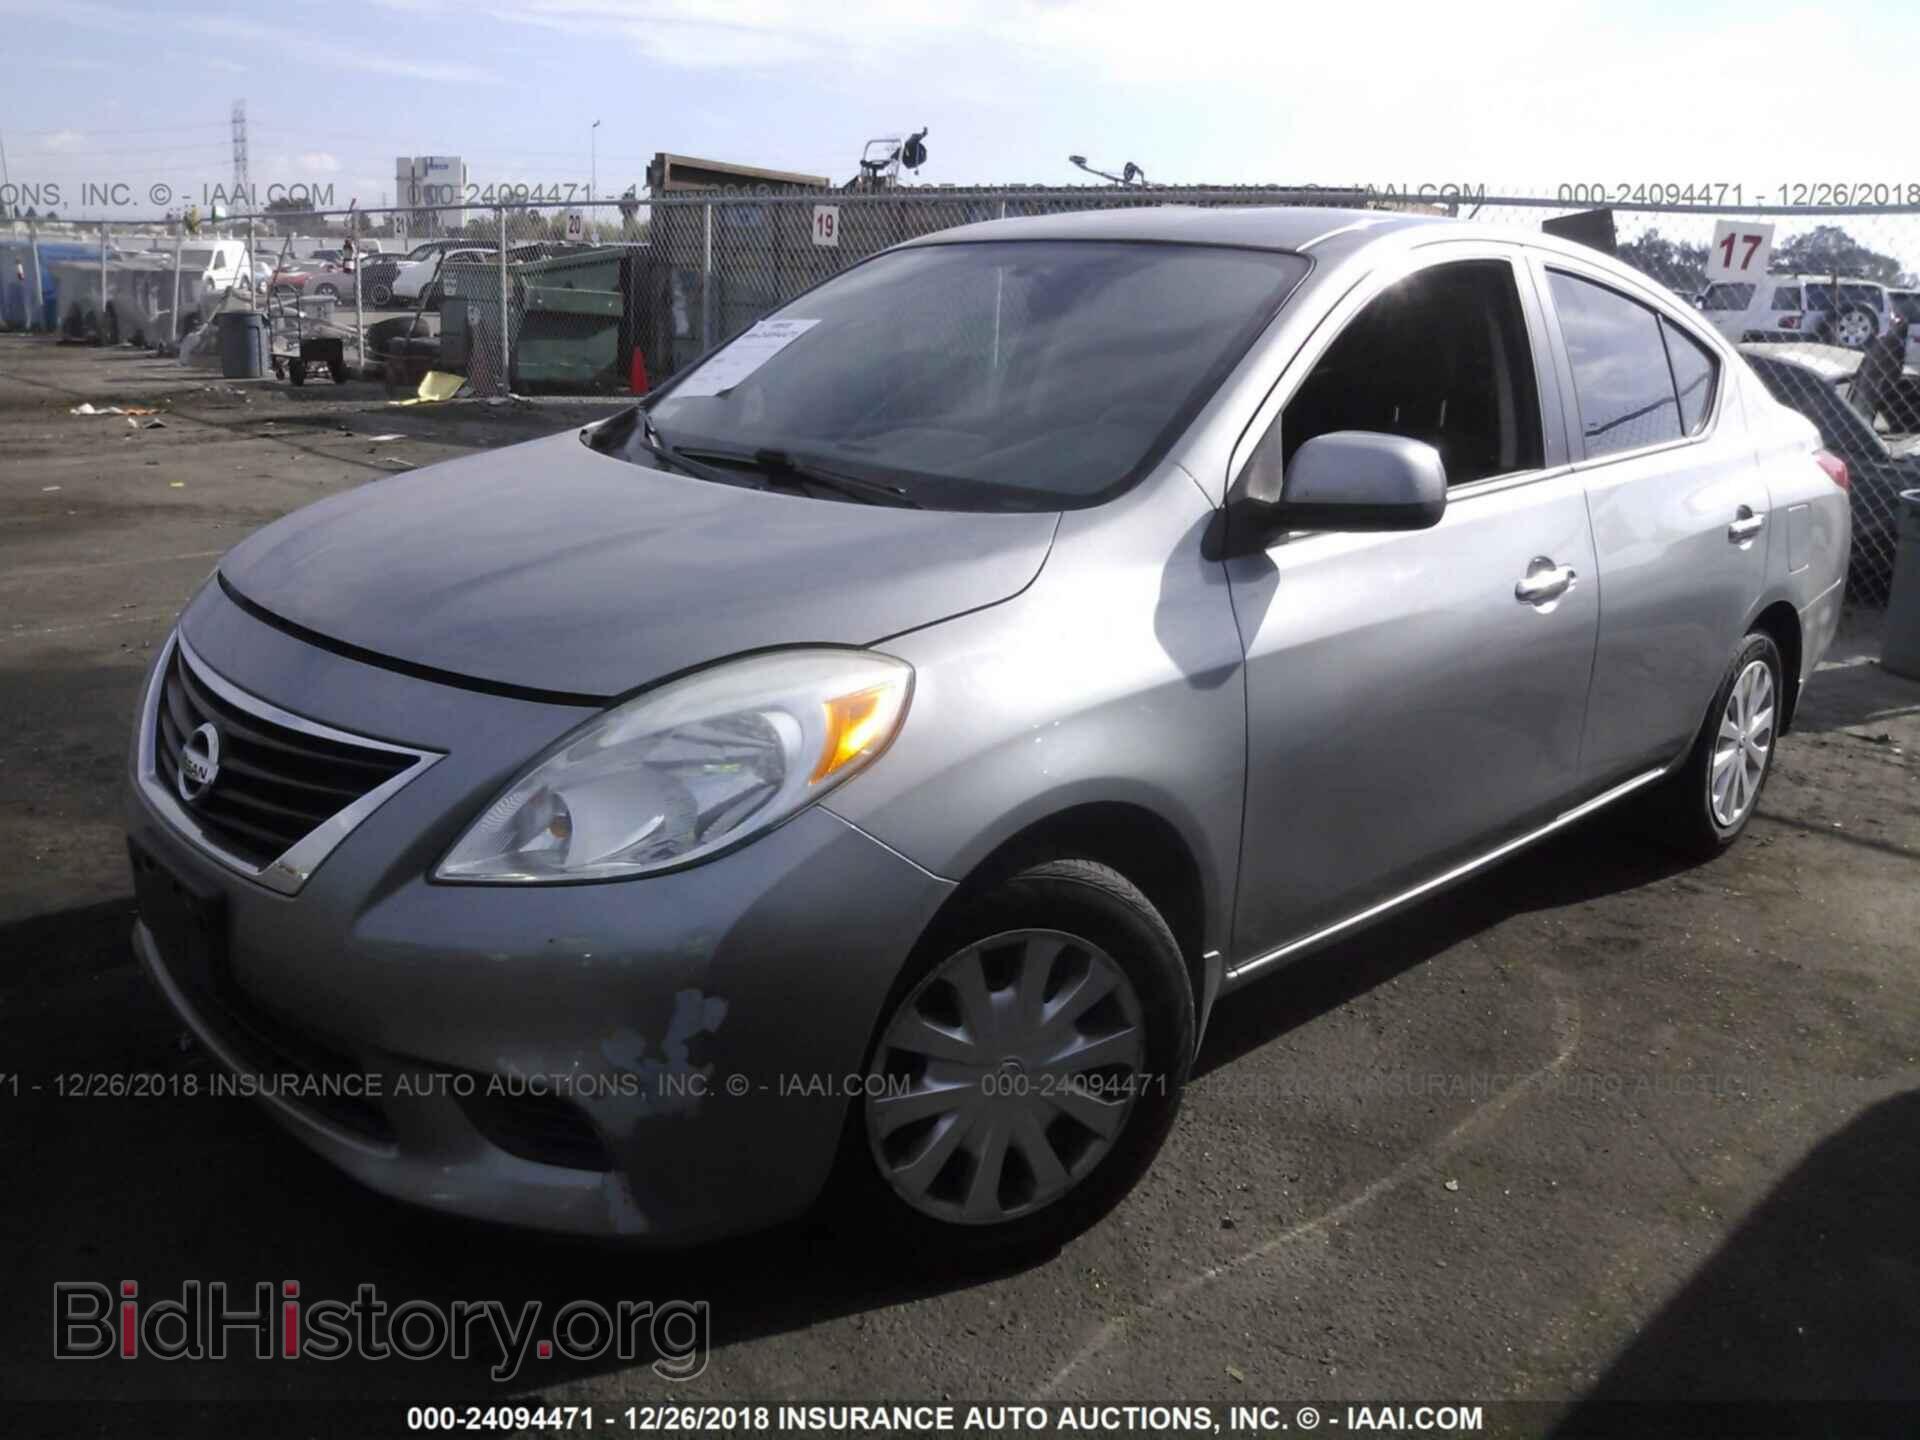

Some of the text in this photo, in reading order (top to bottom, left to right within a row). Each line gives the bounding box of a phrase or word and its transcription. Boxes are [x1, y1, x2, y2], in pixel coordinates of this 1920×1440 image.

[569, 215, 581, 234] 20
[817, 213, 834, 238] 19
[1719, 231, 1763, 271] 17
